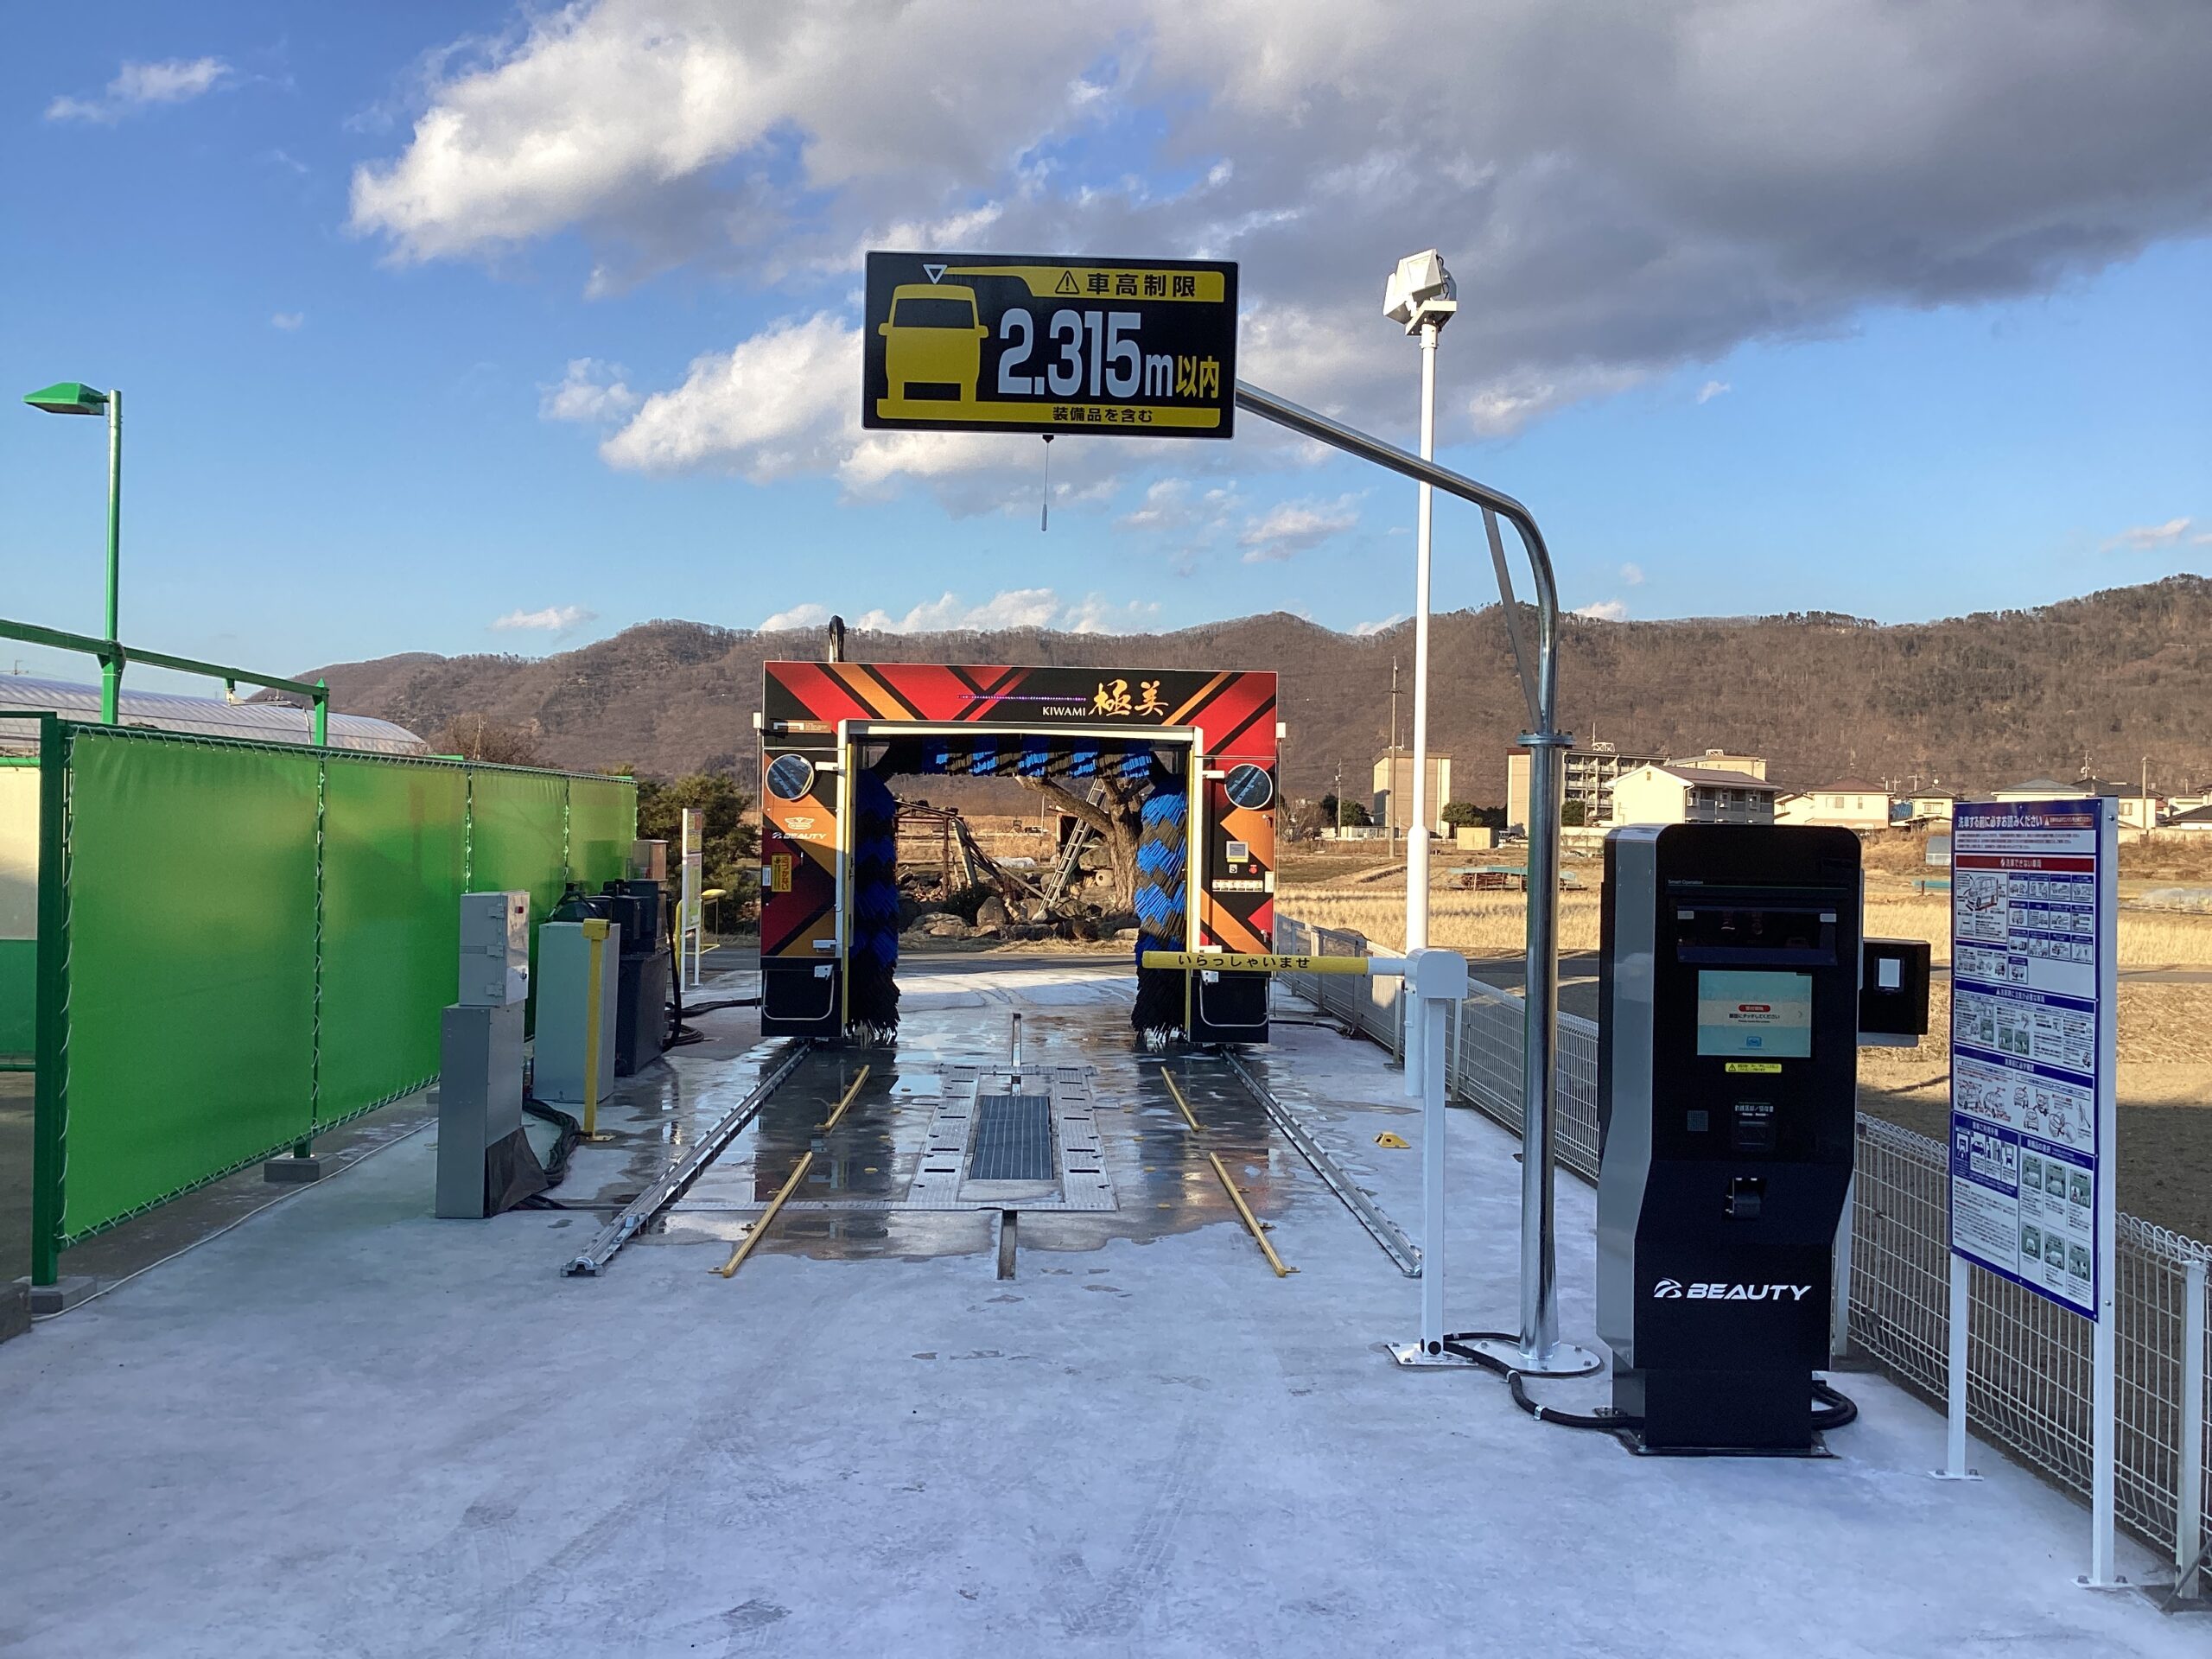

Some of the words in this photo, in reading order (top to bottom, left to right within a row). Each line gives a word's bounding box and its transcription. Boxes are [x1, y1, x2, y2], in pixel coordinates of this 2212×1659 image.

[1086, 272, 1196, 298] 車高制限
[1052, 406, 1154, 423] 装備品を含む
[1088, 679, 1169, 716] 極美
[1042, 706, 1087, 716] KIWAMI
[1178, 954, 1310, 969] いらっしゃいませ
[1686, 1283, 1812, 1300] BEAUTY
